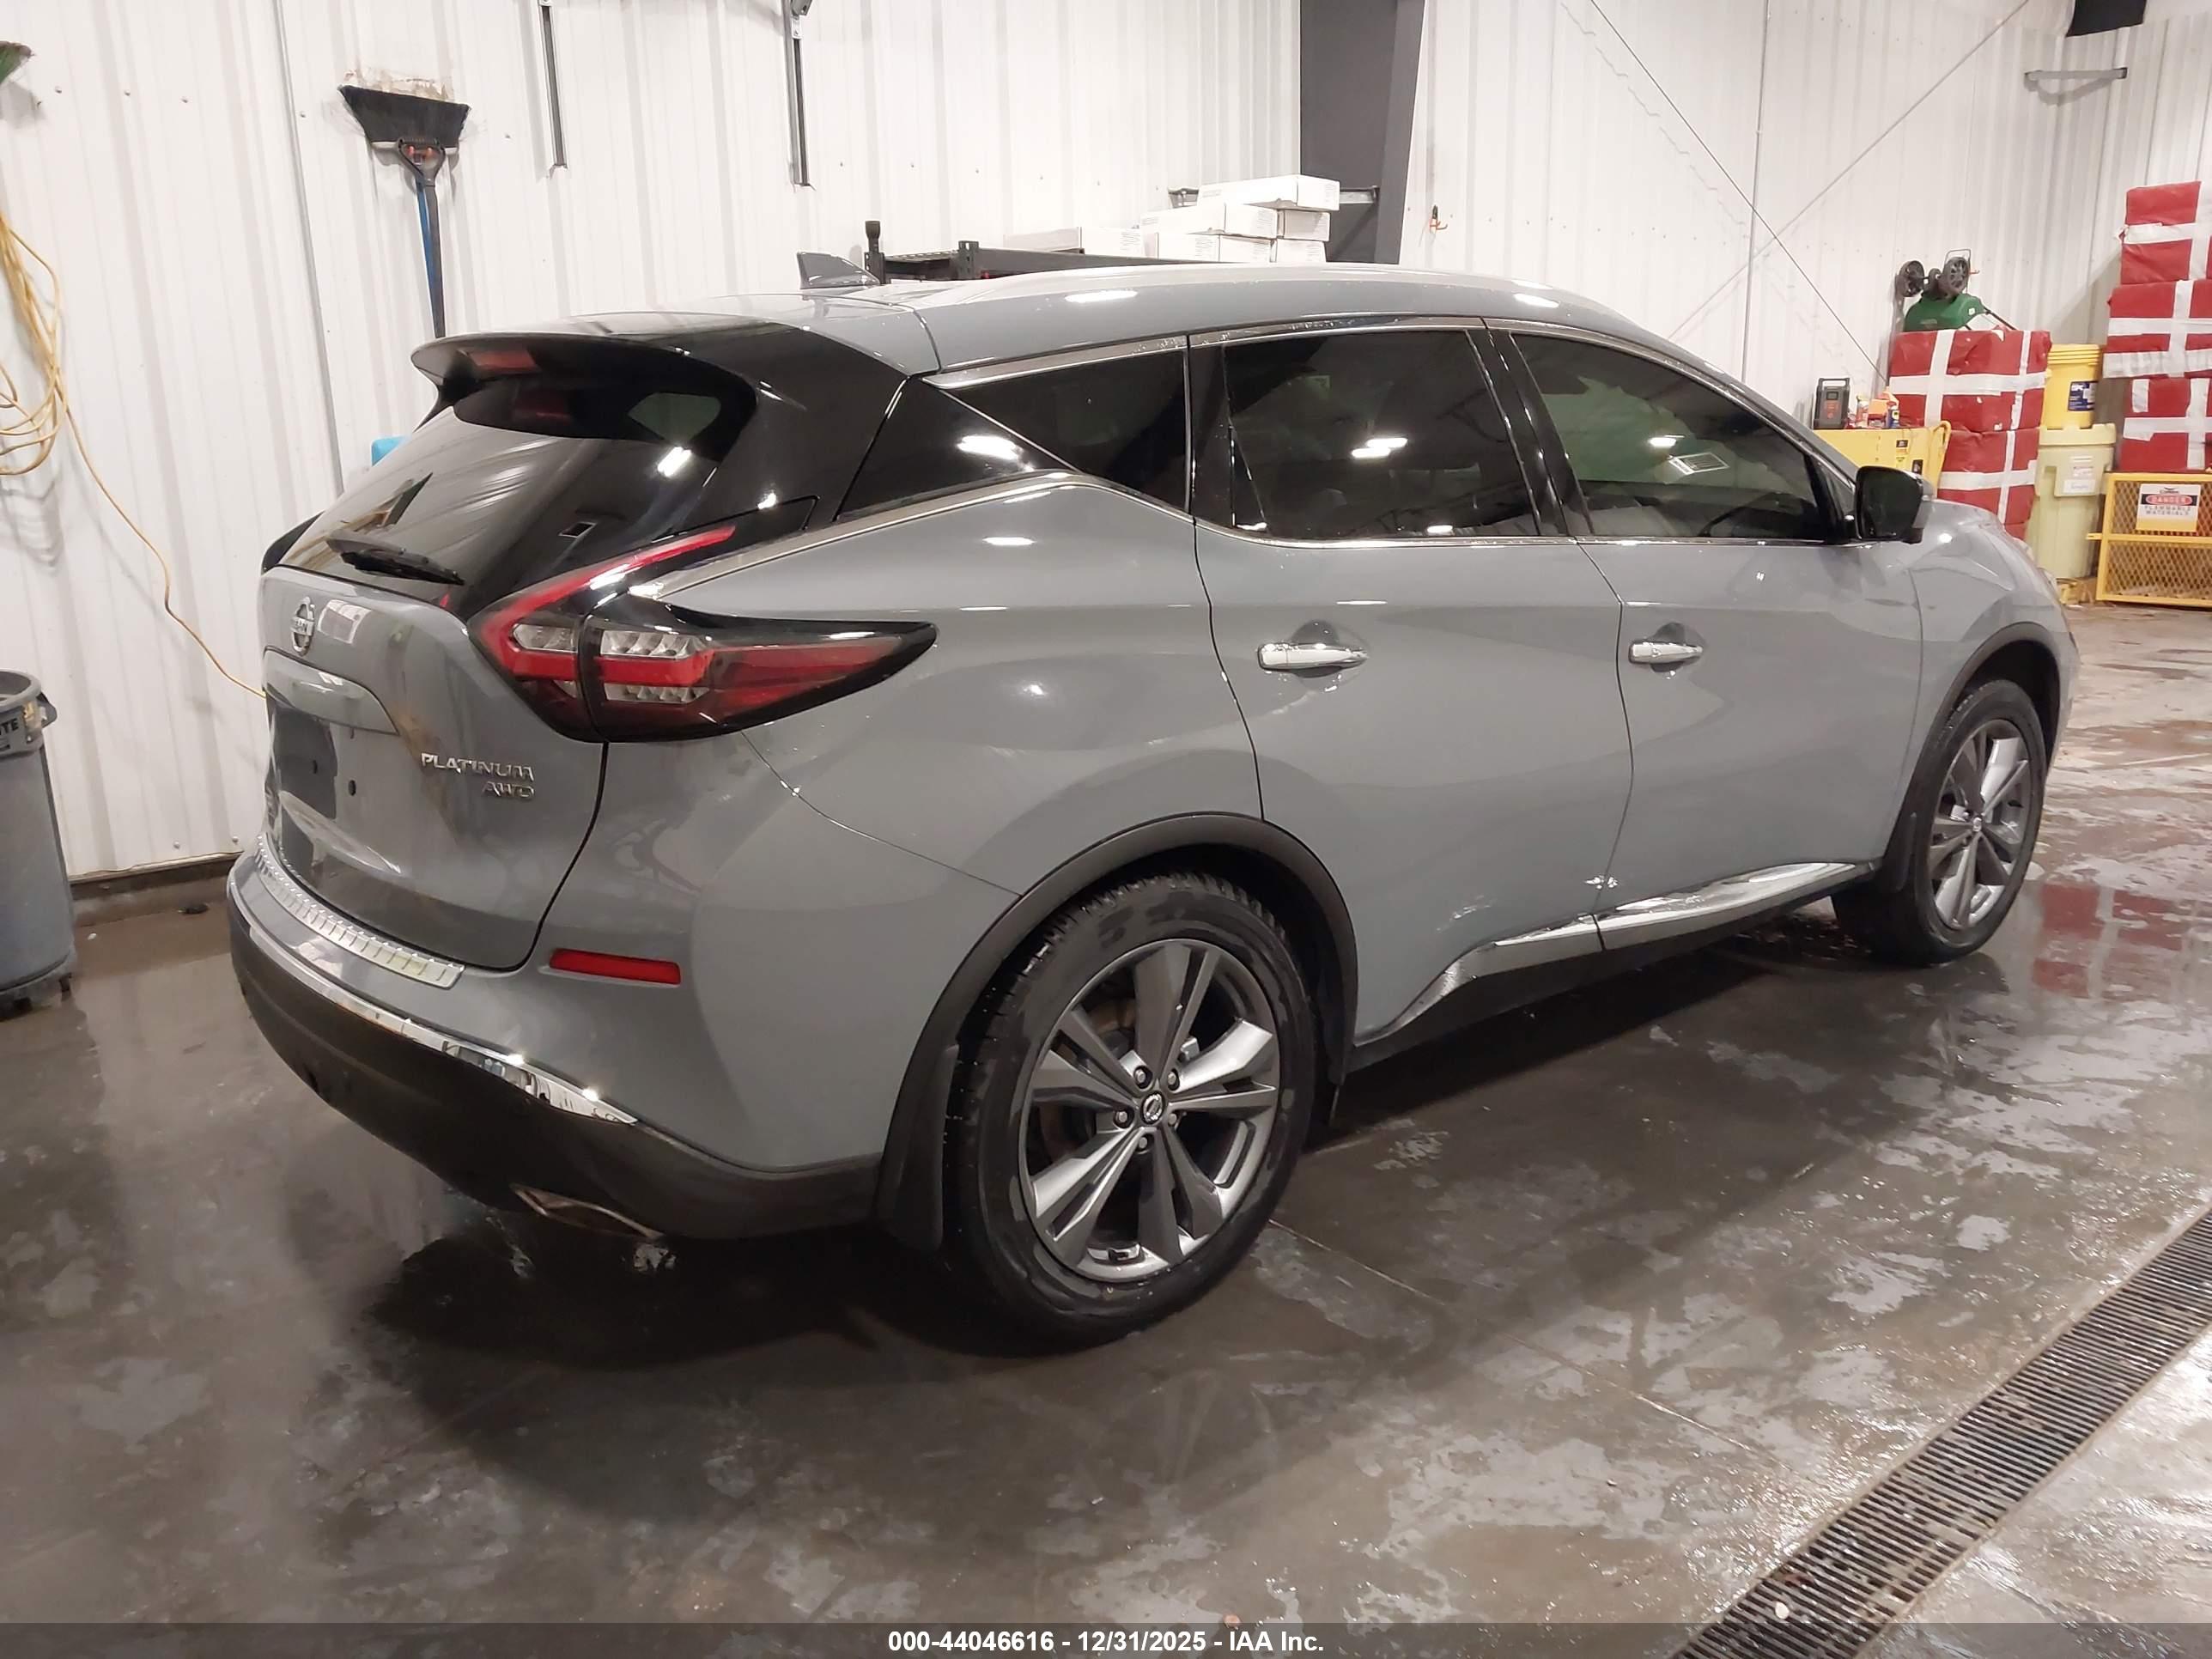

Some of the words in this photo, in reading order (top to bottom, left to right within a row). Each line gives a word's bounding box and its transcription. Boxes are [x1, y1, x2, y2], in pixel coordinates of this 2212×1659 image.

[2150, 495, 2187, 505] DANGER
[0, 718, 19, 735] TE
[421, 752, 534, 781] PLATINUM
[482, 781, 534, 798] AWD
